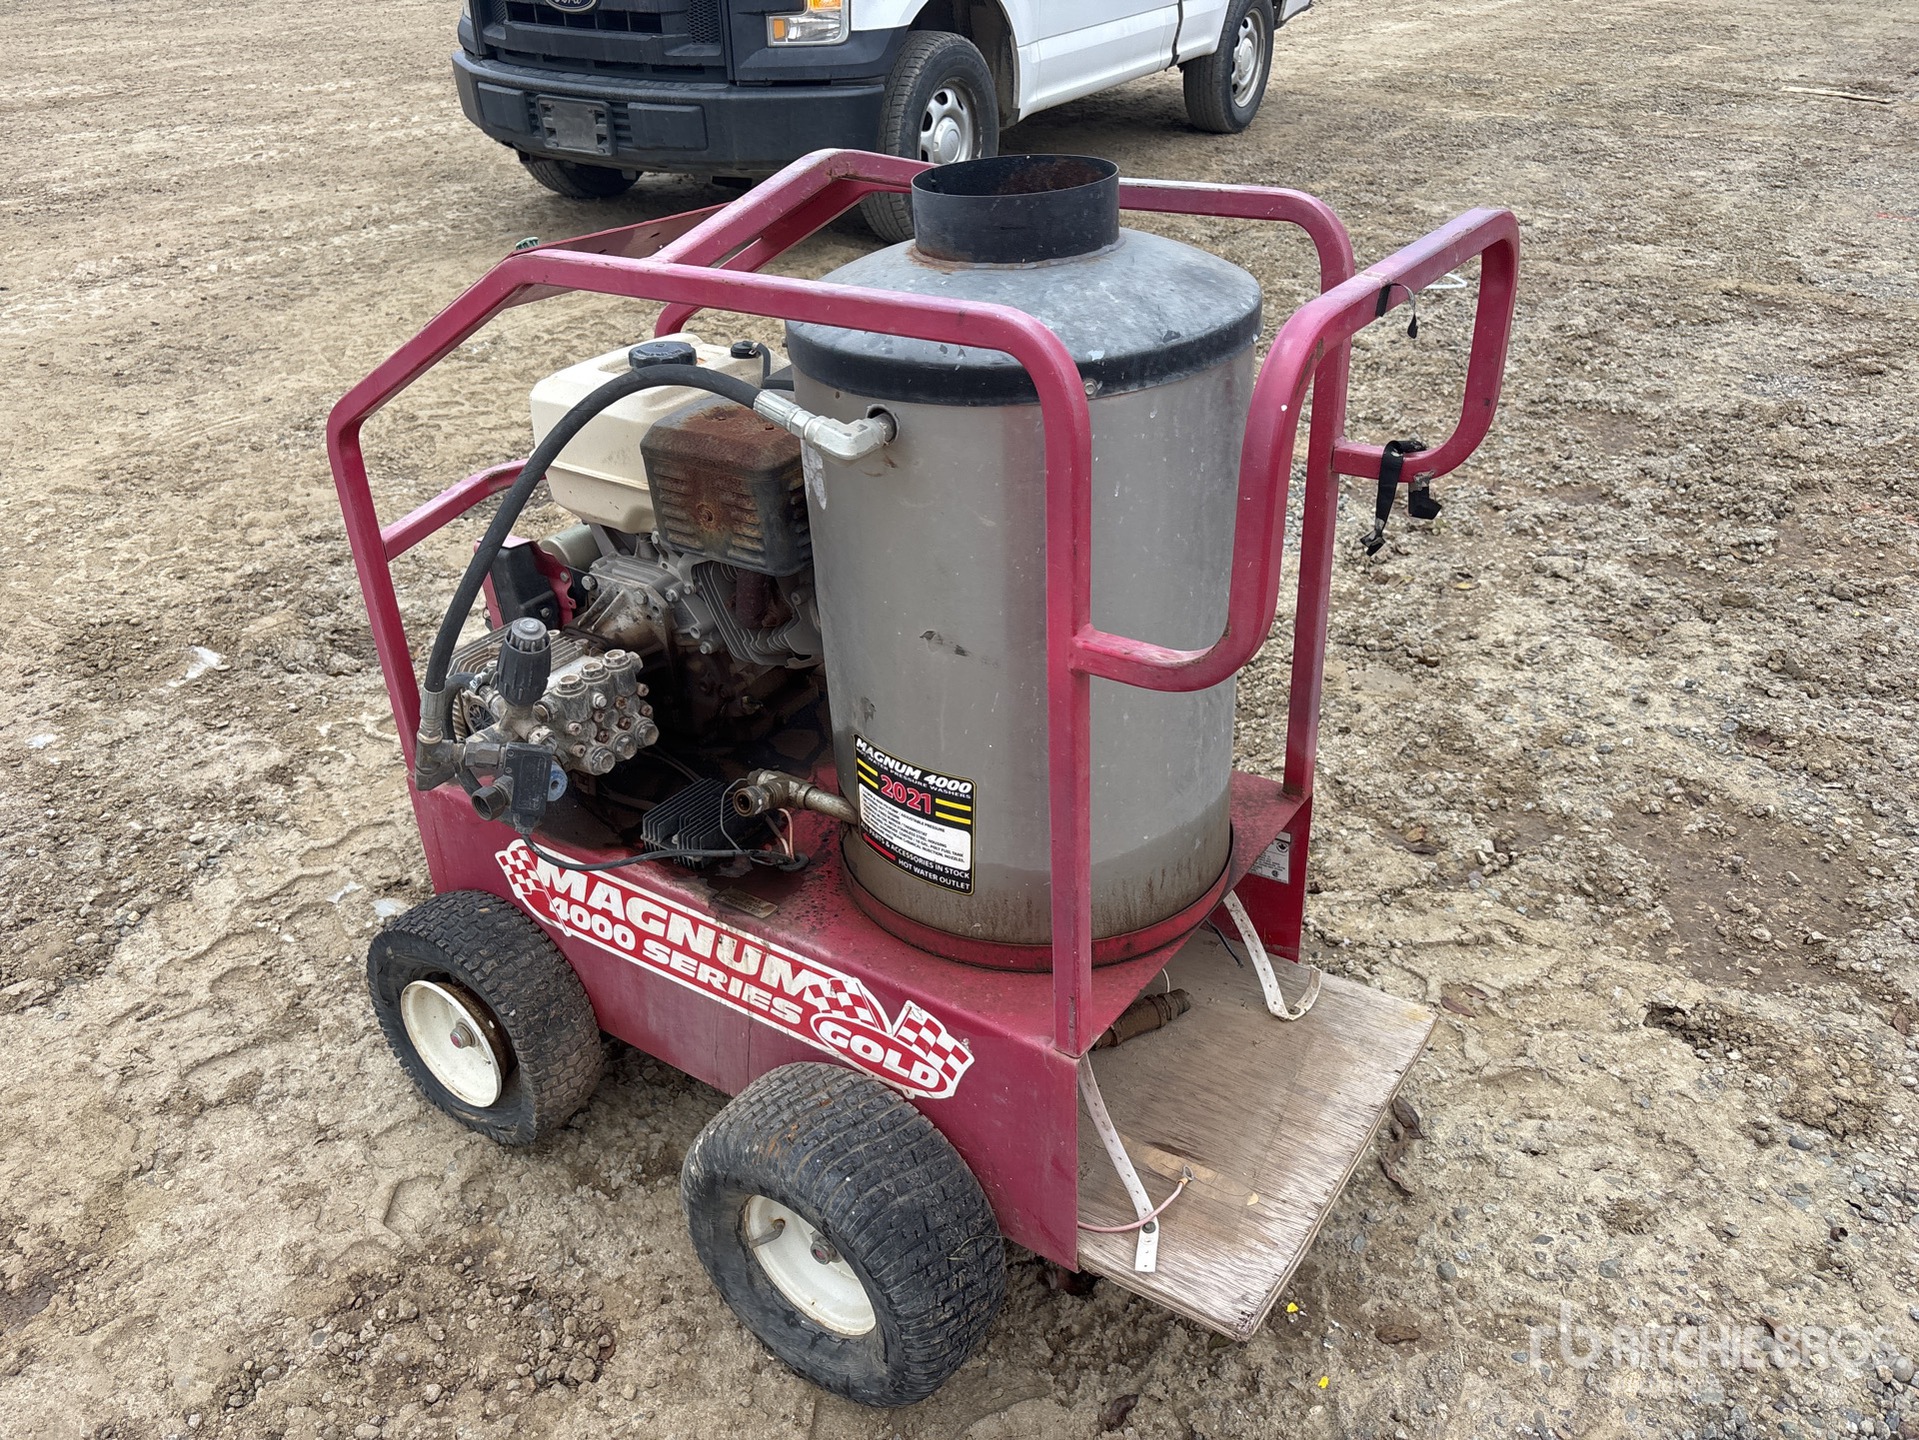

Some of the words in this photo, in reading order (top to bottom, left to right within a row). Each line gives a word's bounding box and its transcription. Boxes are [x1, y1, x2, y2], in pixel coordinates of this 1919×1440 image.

[856, 738, 921, 780] MAGNUM
[924, 774, 972, 794] 4000
[868, 756, 889, 771] WATER
[890, 769, 927, 787] PRESSURE
[930, 785, 971, 799] WASHERS
[881, 774, 931, 814] 2021
[869, 828, 885, 845] PARTS
[891, 845, 934, 868] ACCESSORIES
[935, 863, 943, 872] IN
[944, 867, 970, 879] STOCK
[898, 860, 912, 871] HOT
[913, 865, 938, 880] WATER
[939, 876, 970, 890] OUTLET
[536, 857, 829, 1001] MAGNUM
[549, 896, 636, 951] 4000
[642, 938, 804, 1025] SERIES
[818, 1020, 941, 1089] GOLD
